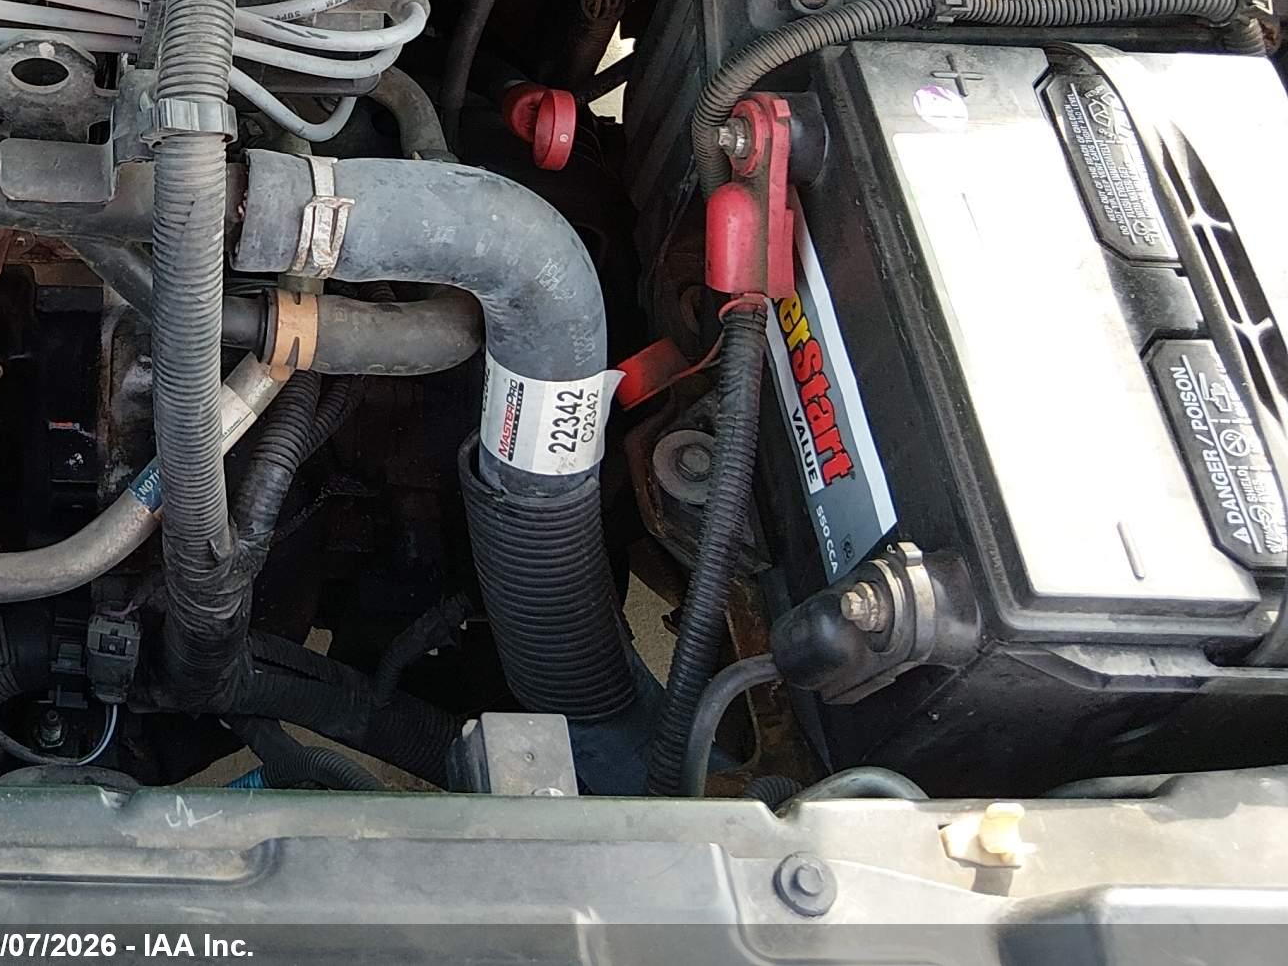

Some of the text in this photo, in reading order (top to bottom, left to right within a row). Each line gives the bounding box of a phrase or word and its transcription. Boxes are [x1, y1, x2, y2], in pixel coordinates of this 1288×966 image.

[548, 388, 584, 454] 22342
[580, 389, 599, 443] C2342
[773, 290, 854, 486] erStart
[1170, 366, 1209, 431] POISON
[792, 407, 818, 485] VALUE
[1203, 448, 1246, 524] DANGER
[815, 505, 839, 574] 550 CCA
